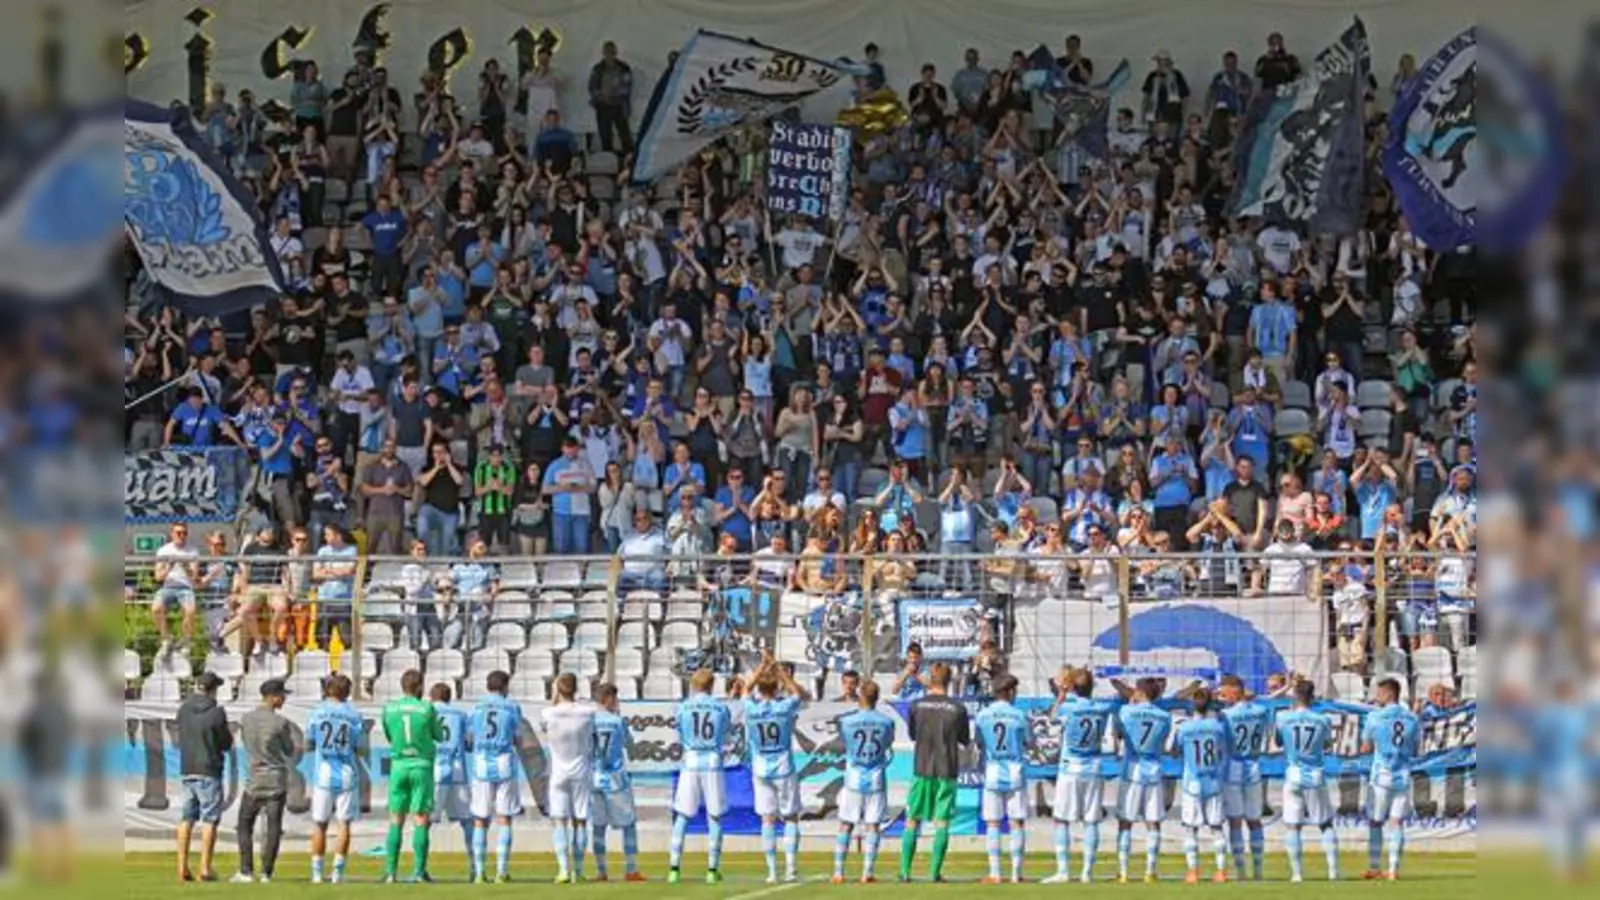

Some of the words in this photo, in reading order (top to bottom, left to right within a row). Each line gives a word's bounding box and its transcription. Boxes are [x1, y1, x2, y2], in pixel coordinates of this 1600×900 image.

[319, 720, 349, 749] 24
[401, 715, 412, 744] 1
[485, 711, 498, 739] 5
[691, 711, 715, 741] 16
[757, 722, 781, 746] 19
[992, 721, 1008, 752] 2
[1079, 718, 1101, 748] 21
[1139, 721, 1153, 746] 7
[1235, 723, 1262, 752] 26
[1292, 725, 1316, 751] 17
[1392, 720, 1405, 747] 8
[853, 728, 882, 757] 25
[1192, 739, 1215, 768] 18
